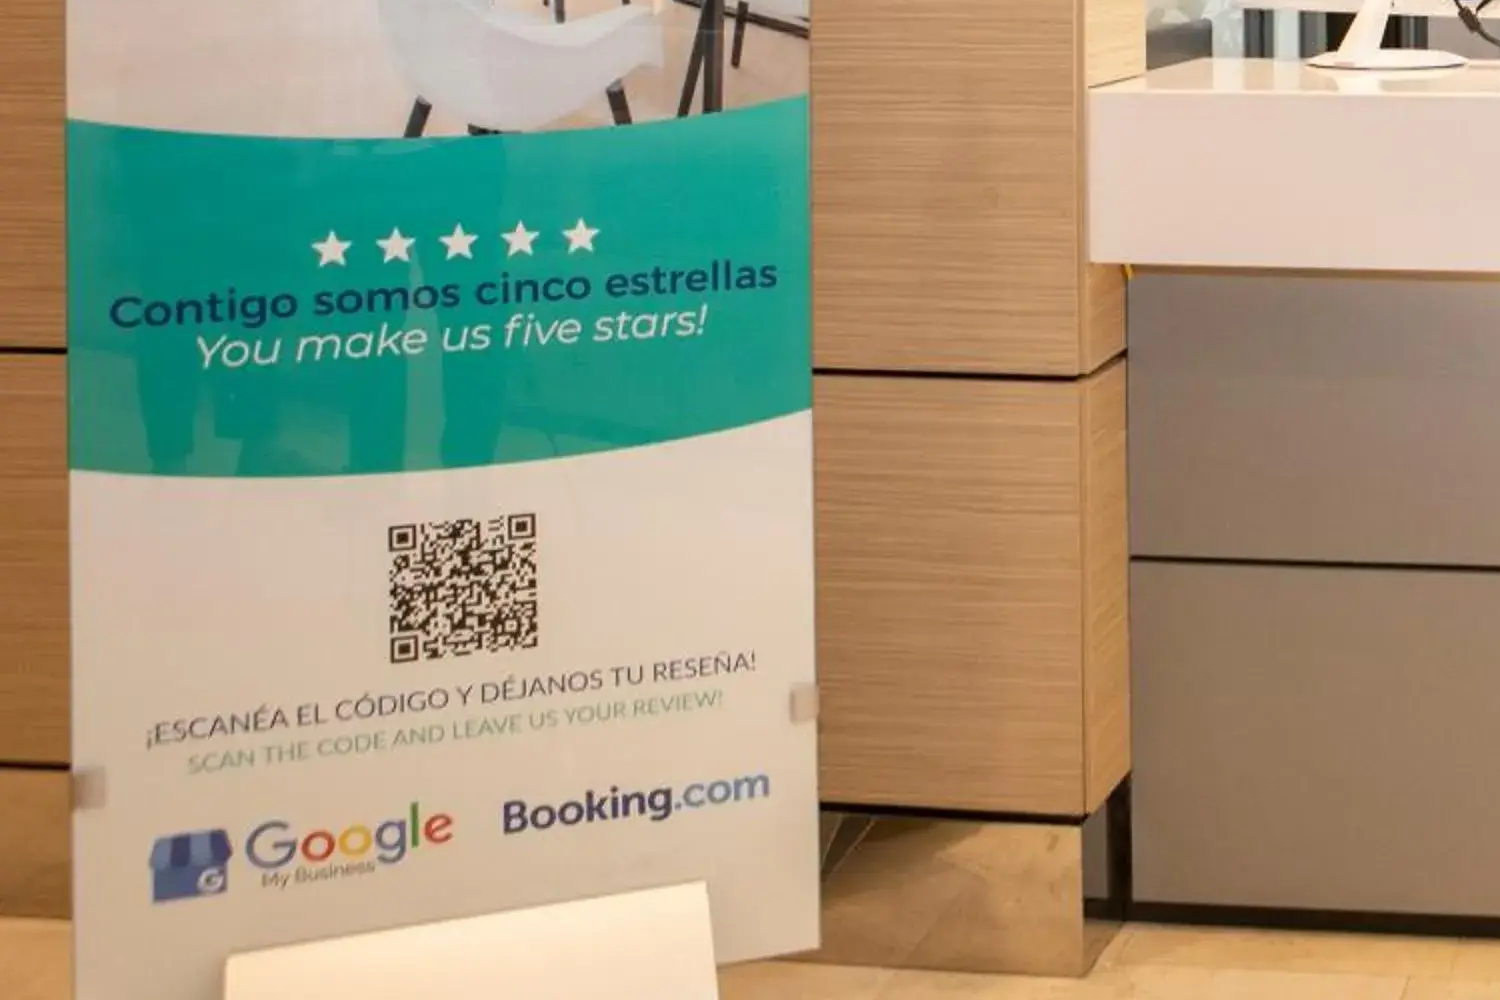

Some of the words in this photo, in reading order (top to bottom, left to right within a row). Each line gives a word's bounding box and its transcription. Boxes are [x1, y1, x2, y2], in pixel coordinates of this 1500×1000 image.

[110, 287, 298, 328] Contigo
[313, 283, 461, 316] somos
[475, 271, 591, 305] cinco
[605, 259, 778, 298] estrellas
[196, 333, 281, 369] You
[295, 322, 428, 363] make
[442, 323, 492, 351] us
[503, 311, 582, 348] five
[592, 303, 709, 342] stars!
[147, 703, 289, 748] ¡ESCANÉA
[297, 703, 328, 727] EL
[335, 688, 449, 721] CÓDIGO
[456, 683, 474, 708] Y
[480, 668, 603, 705] DÉJANOS
[611, 665, 644, 687] TU
[652, 651, 757, 683] RESEÑA!
[187, 749, 255, 775] SCAN
[263, 740, 312, 765] THE
[316, 730, 388, 757] CODE
[392, 723, 446, 746] AND
[452, 713, 522, 740] LEAVE
[529, 708, 559, 730] US
[565, 701, 626, 725] YOUR
[633, 689, 723, 717] REVIEW!
[245, 801, 453, 869] Google
[503, 773, 770, 835] Booking.com
[197, 867, 223, 892] G
[261, 870, 290, 891] My
[295, 858, 377, 885] Business
